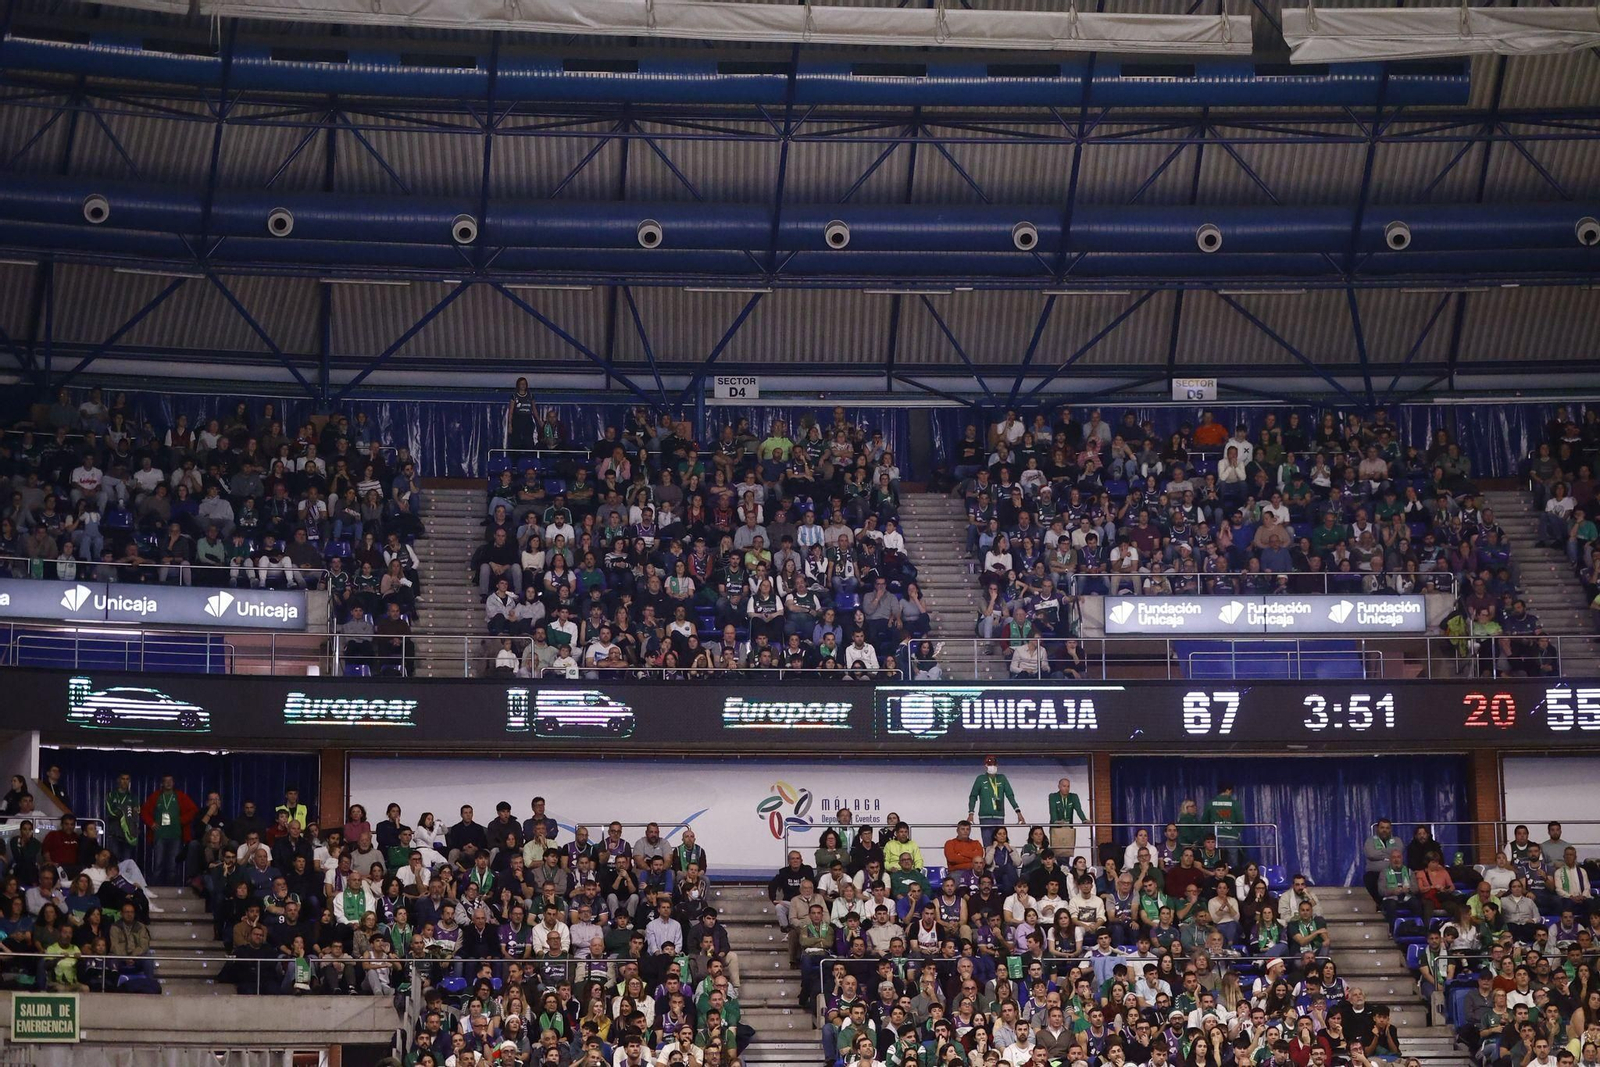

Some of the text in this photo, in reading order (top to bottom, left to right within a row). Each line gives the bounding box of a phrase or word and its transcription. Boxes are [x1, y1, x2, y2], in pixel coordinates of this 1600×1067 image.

[717, 377, 756, 385] SECTOR
[1175, 380, 1214, 388] SECTOR
[729, 387, 746, 397] D4
[1187, 390, 1204, 400] D5
[94, 595, 157, 613] Unicaja
[1137, 602, 1201, 614] Fundación
[1247, 602, 1311, 614] Fundación
[1357, 602, 1420, 613] Fundación
[237, 602, 298, 622] Unicaja
[1138, 613, 1184, 627] Unicaja
[1247, 613, 1294, 627] Unicaja
[1357, 612, 1403, 627] Unicaja
[962, 699, 1098, 729] UNICAJA
[1183, 692, 1240, 734] 67
[1303, 693, 1394, 732] 3:51
[1463, 692, 1516, 730] 20
[1546, 689, 1600, 731] 55
[855, 814, 880, 823] Eventos
[279, 915, 285, 924] 9
[20, 1003, 70, 1017] SALIDA DE
[16, 1020, 73, 1033] EMERGENCIA
